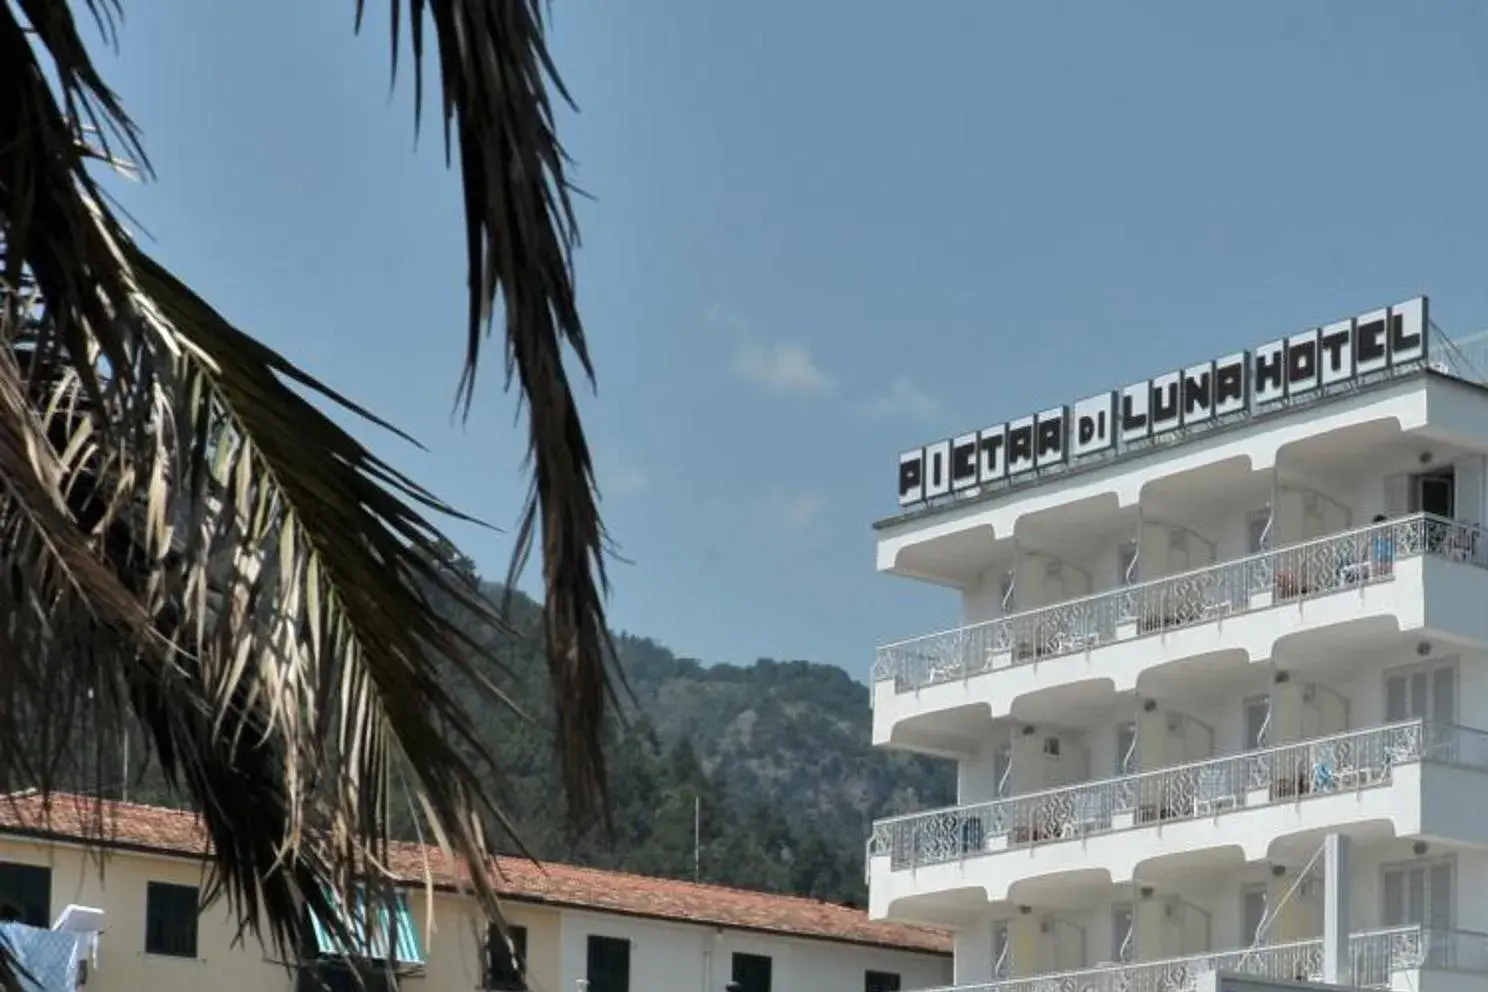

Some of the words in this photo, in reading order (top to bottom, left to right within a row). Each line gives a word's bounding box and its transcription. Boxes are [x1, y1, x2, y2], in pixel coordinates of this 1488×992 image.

[899, 416, 1064, 497] PIETRA
[1078, 410, 1106, 447] DI
[1122, 362, 1243, 431] LUNA
[1256, 313, 1421, 393] HOTEL
